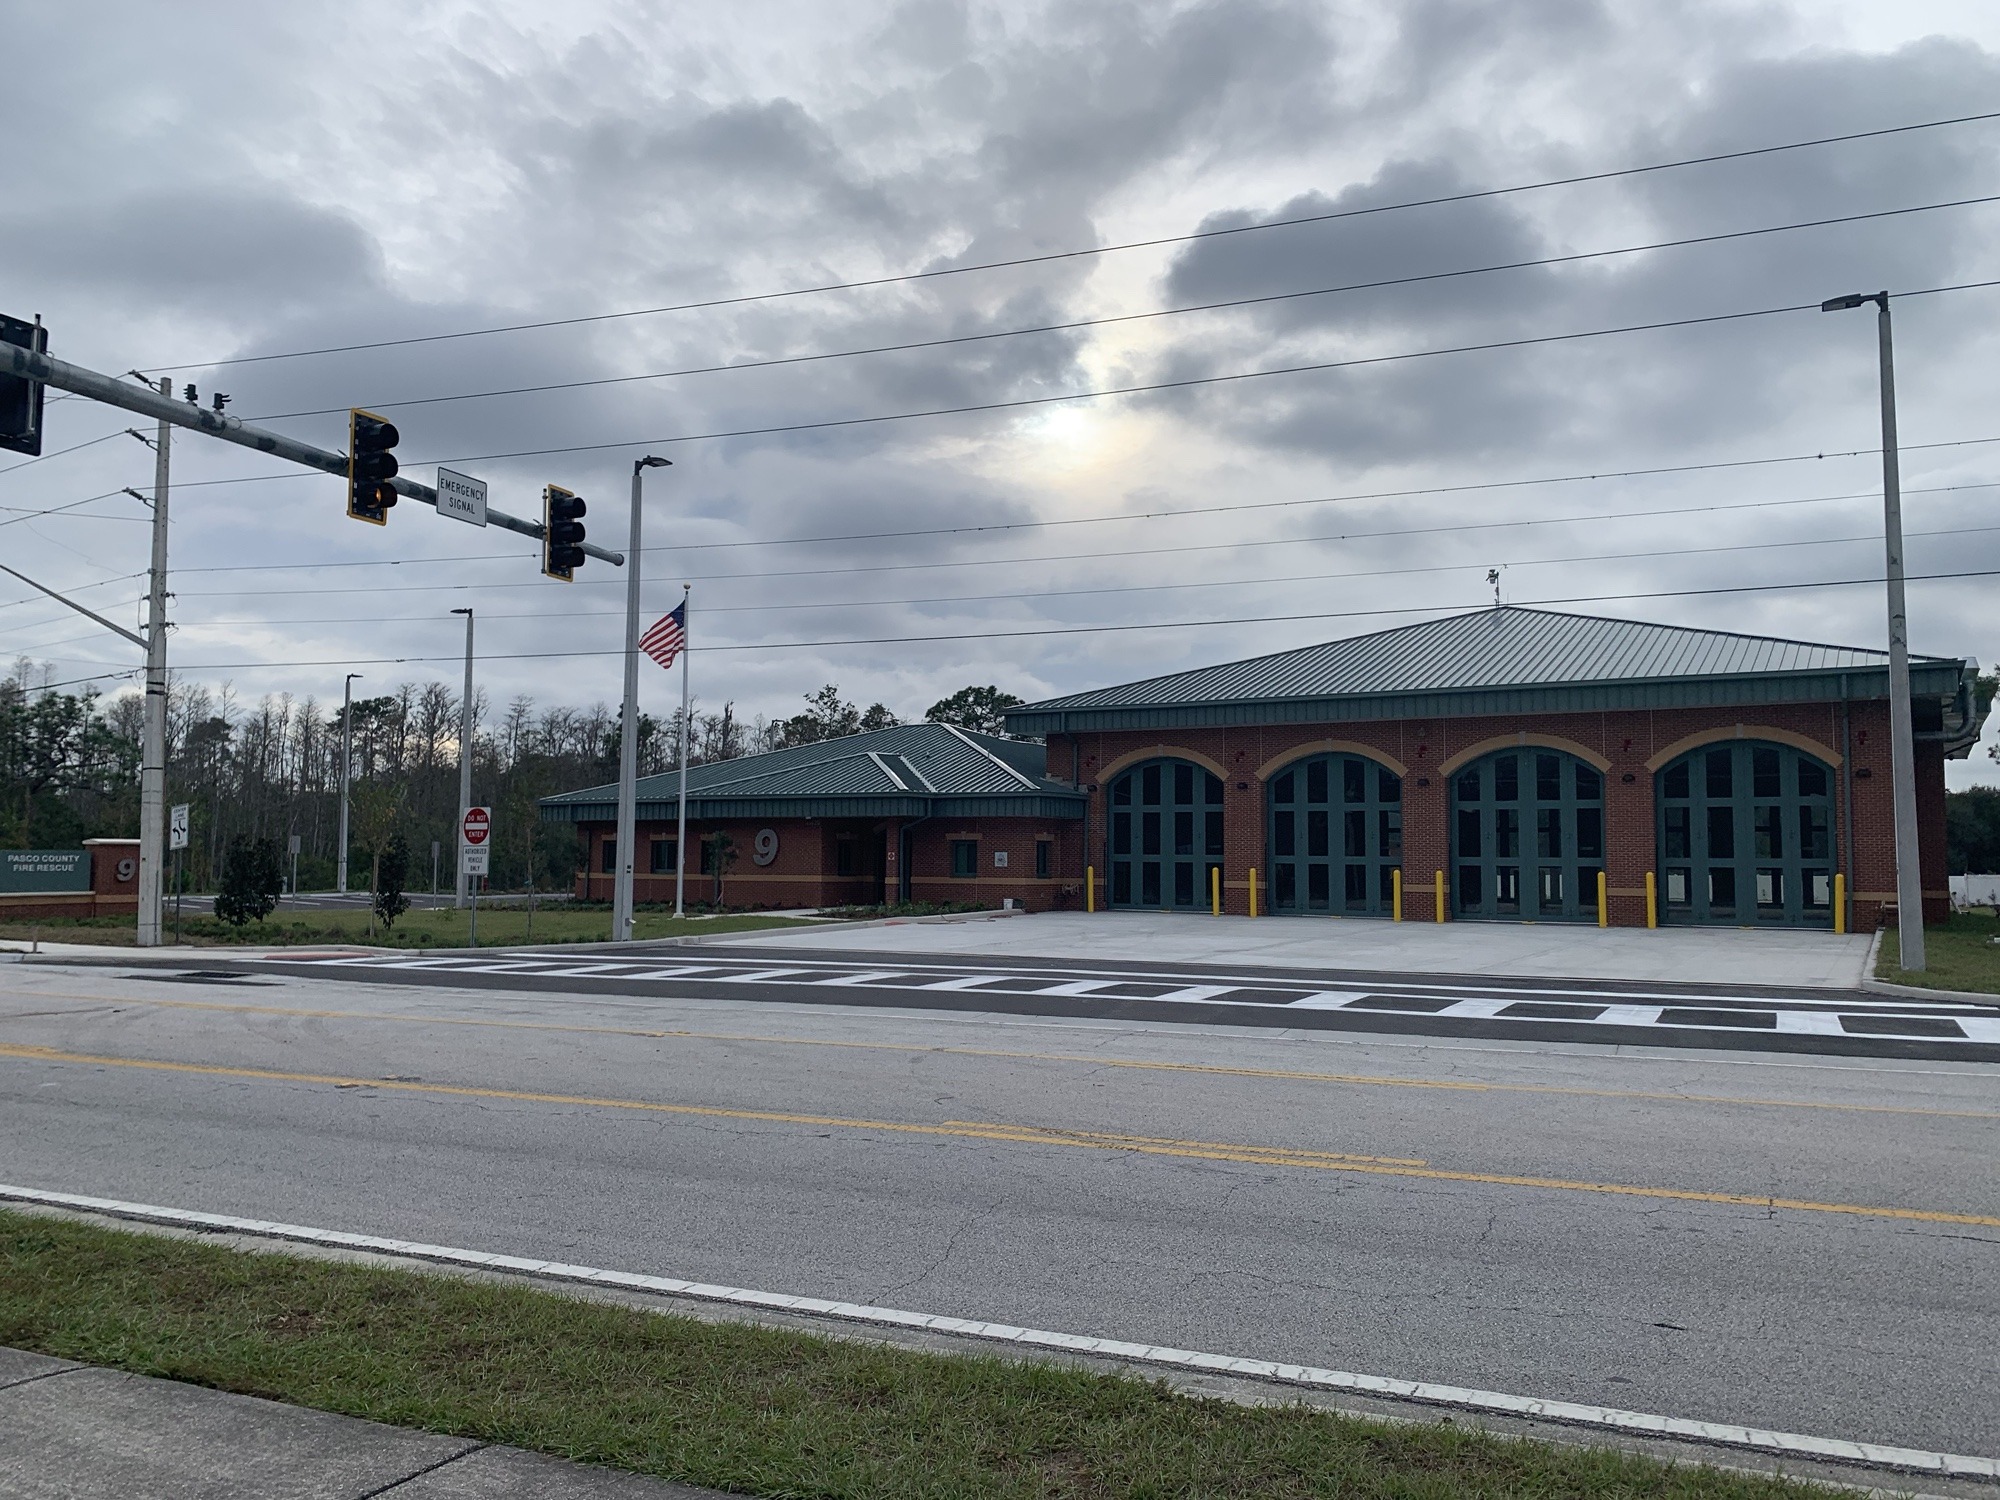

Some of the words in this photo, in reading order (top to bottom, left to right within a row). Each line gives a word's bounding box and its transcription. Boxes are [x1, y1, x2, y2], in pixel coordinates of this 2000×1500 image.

[440, 478, 484, 501] EMERGENCY
[448, 496, 475, 514] SIGNAL
[753, 828, 778, 866] 9
[13, 864, 35, 872] FIRE
[37, 864, 75, 872] RESCUE
[116, 858, 136, 882] 9
